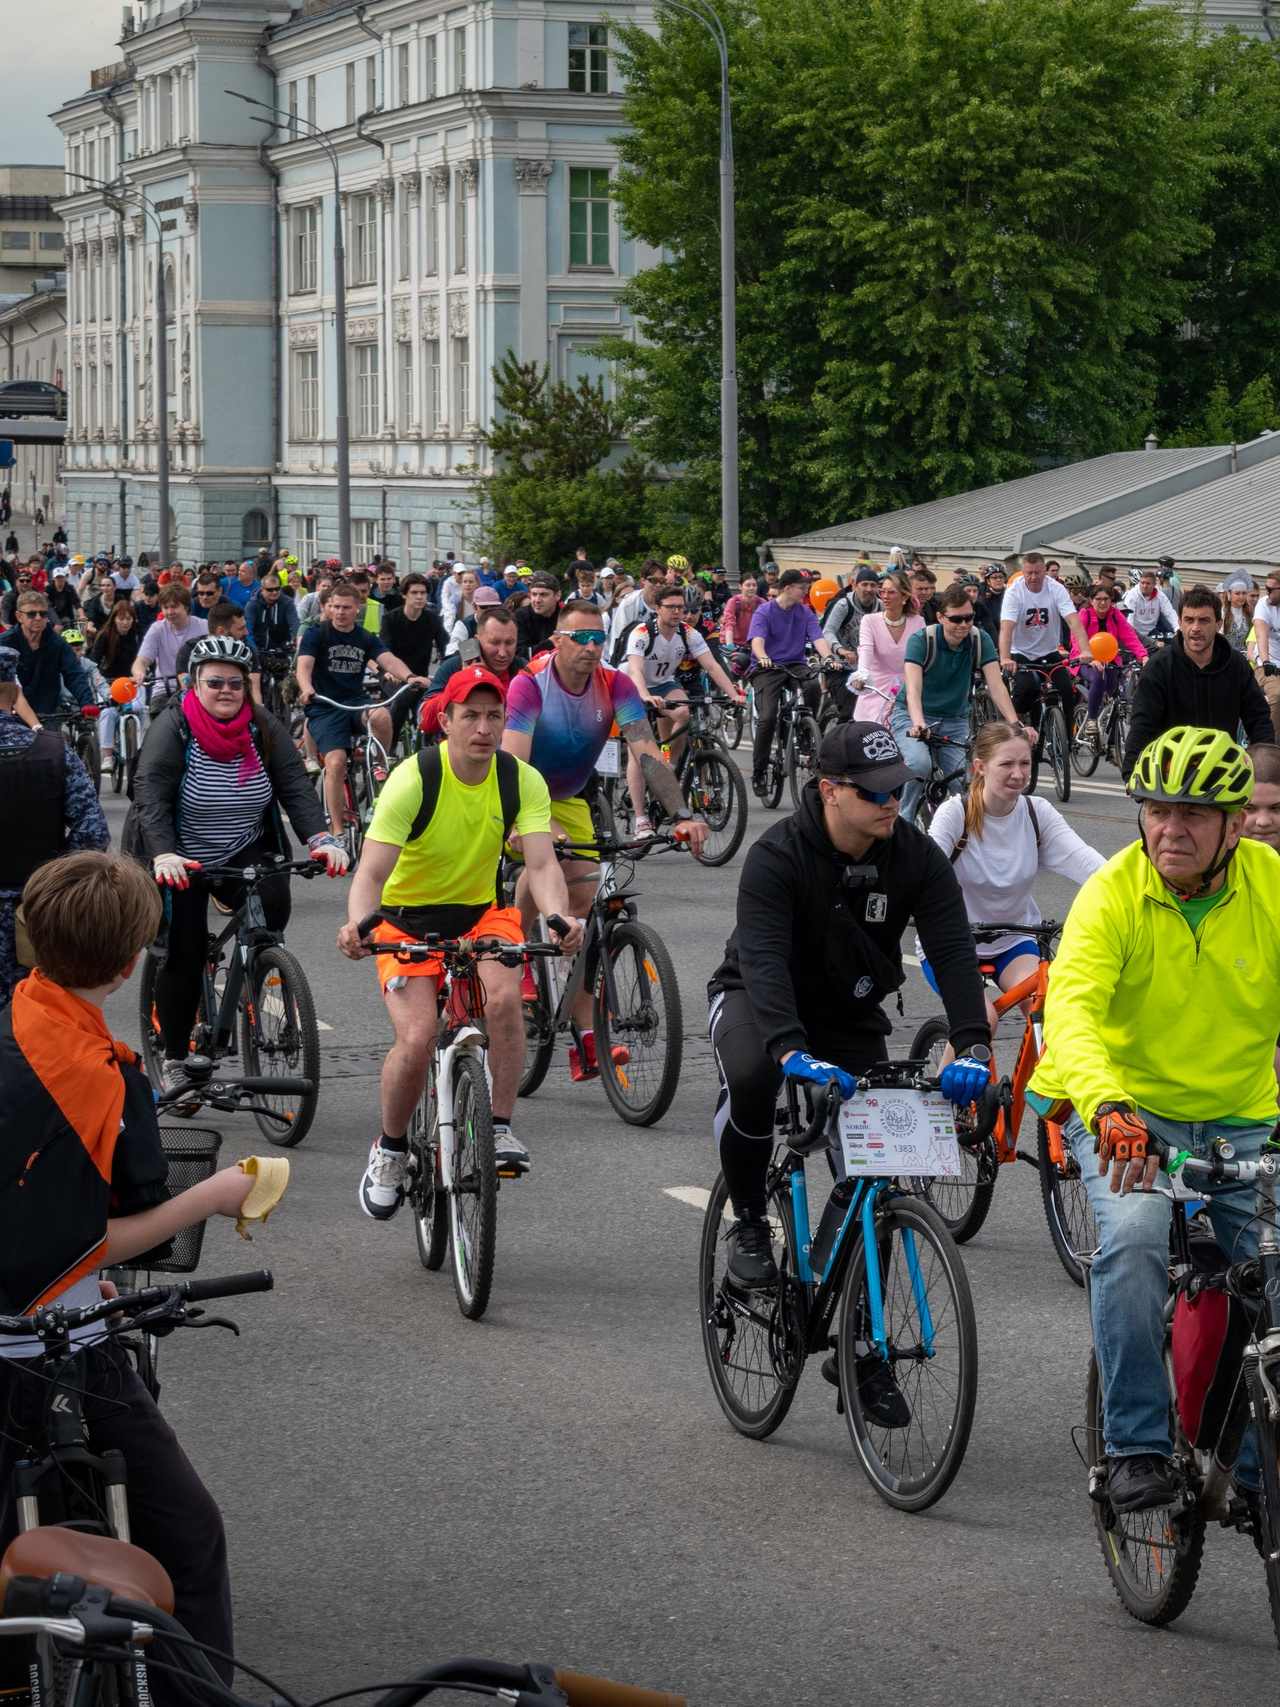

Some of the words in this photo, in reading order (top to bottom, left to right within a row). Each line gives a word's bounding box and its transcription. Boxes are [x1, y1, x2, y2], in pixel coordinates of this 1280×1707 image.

[1026, 608, 1049, 626] 23
[328, 645, 365, 662] TOMMY
[328, 660, 362, 673] JEANS
[655, 662, 670, 676] 17
[893, 1144, 917, 1153] 13831
[134, 1649, 150, 1707] ROCKSHX
